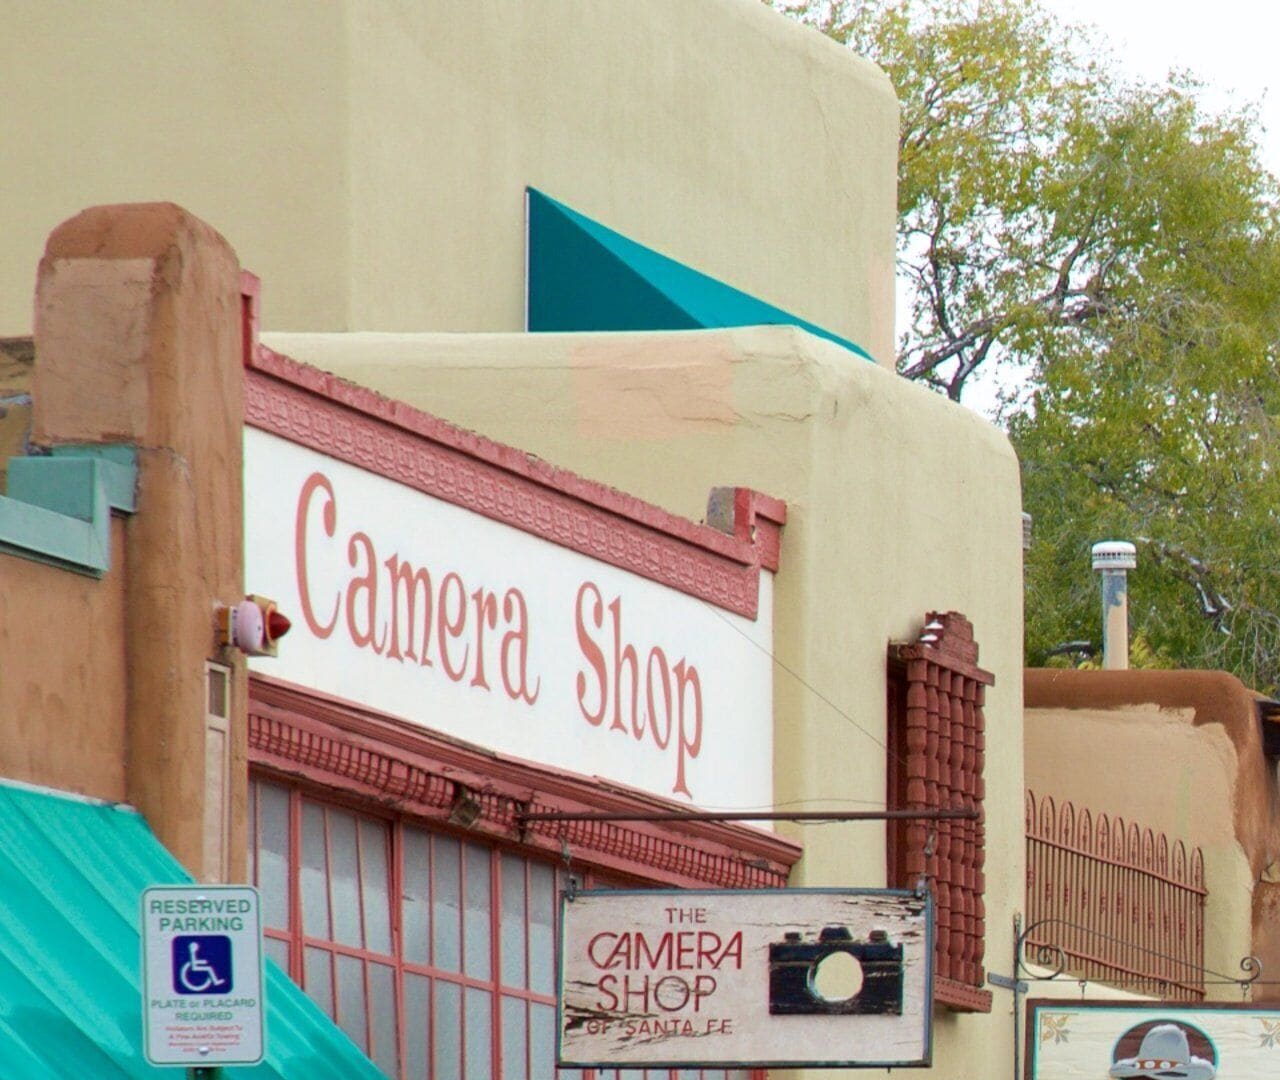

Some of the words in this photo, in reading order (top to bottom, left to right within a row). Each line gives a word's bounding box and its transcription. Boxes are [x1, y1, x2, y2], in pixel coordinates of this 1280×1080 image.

[295, 471, 540, 706] Camera
[576, 580, 703, 798] Shop
[150, 899, 250, 914] RESERVED
[665, 907, 707, 923] THE
[159, 917, 244, 931] PARKING
[587, 931, 744, 971] CAMERA
[597, 974, 717, 1013] SHOP
[151, 999, 186, 1009] PLATE
[203, 998, 256, 1008] PLACARD
[175, 1011, 233, 1021] REQUIRED
[586, 1019, 608, 1035] OF
[625, 1019, 693, 1035] SANTA
[707, 1019, 733, 1034] FE
